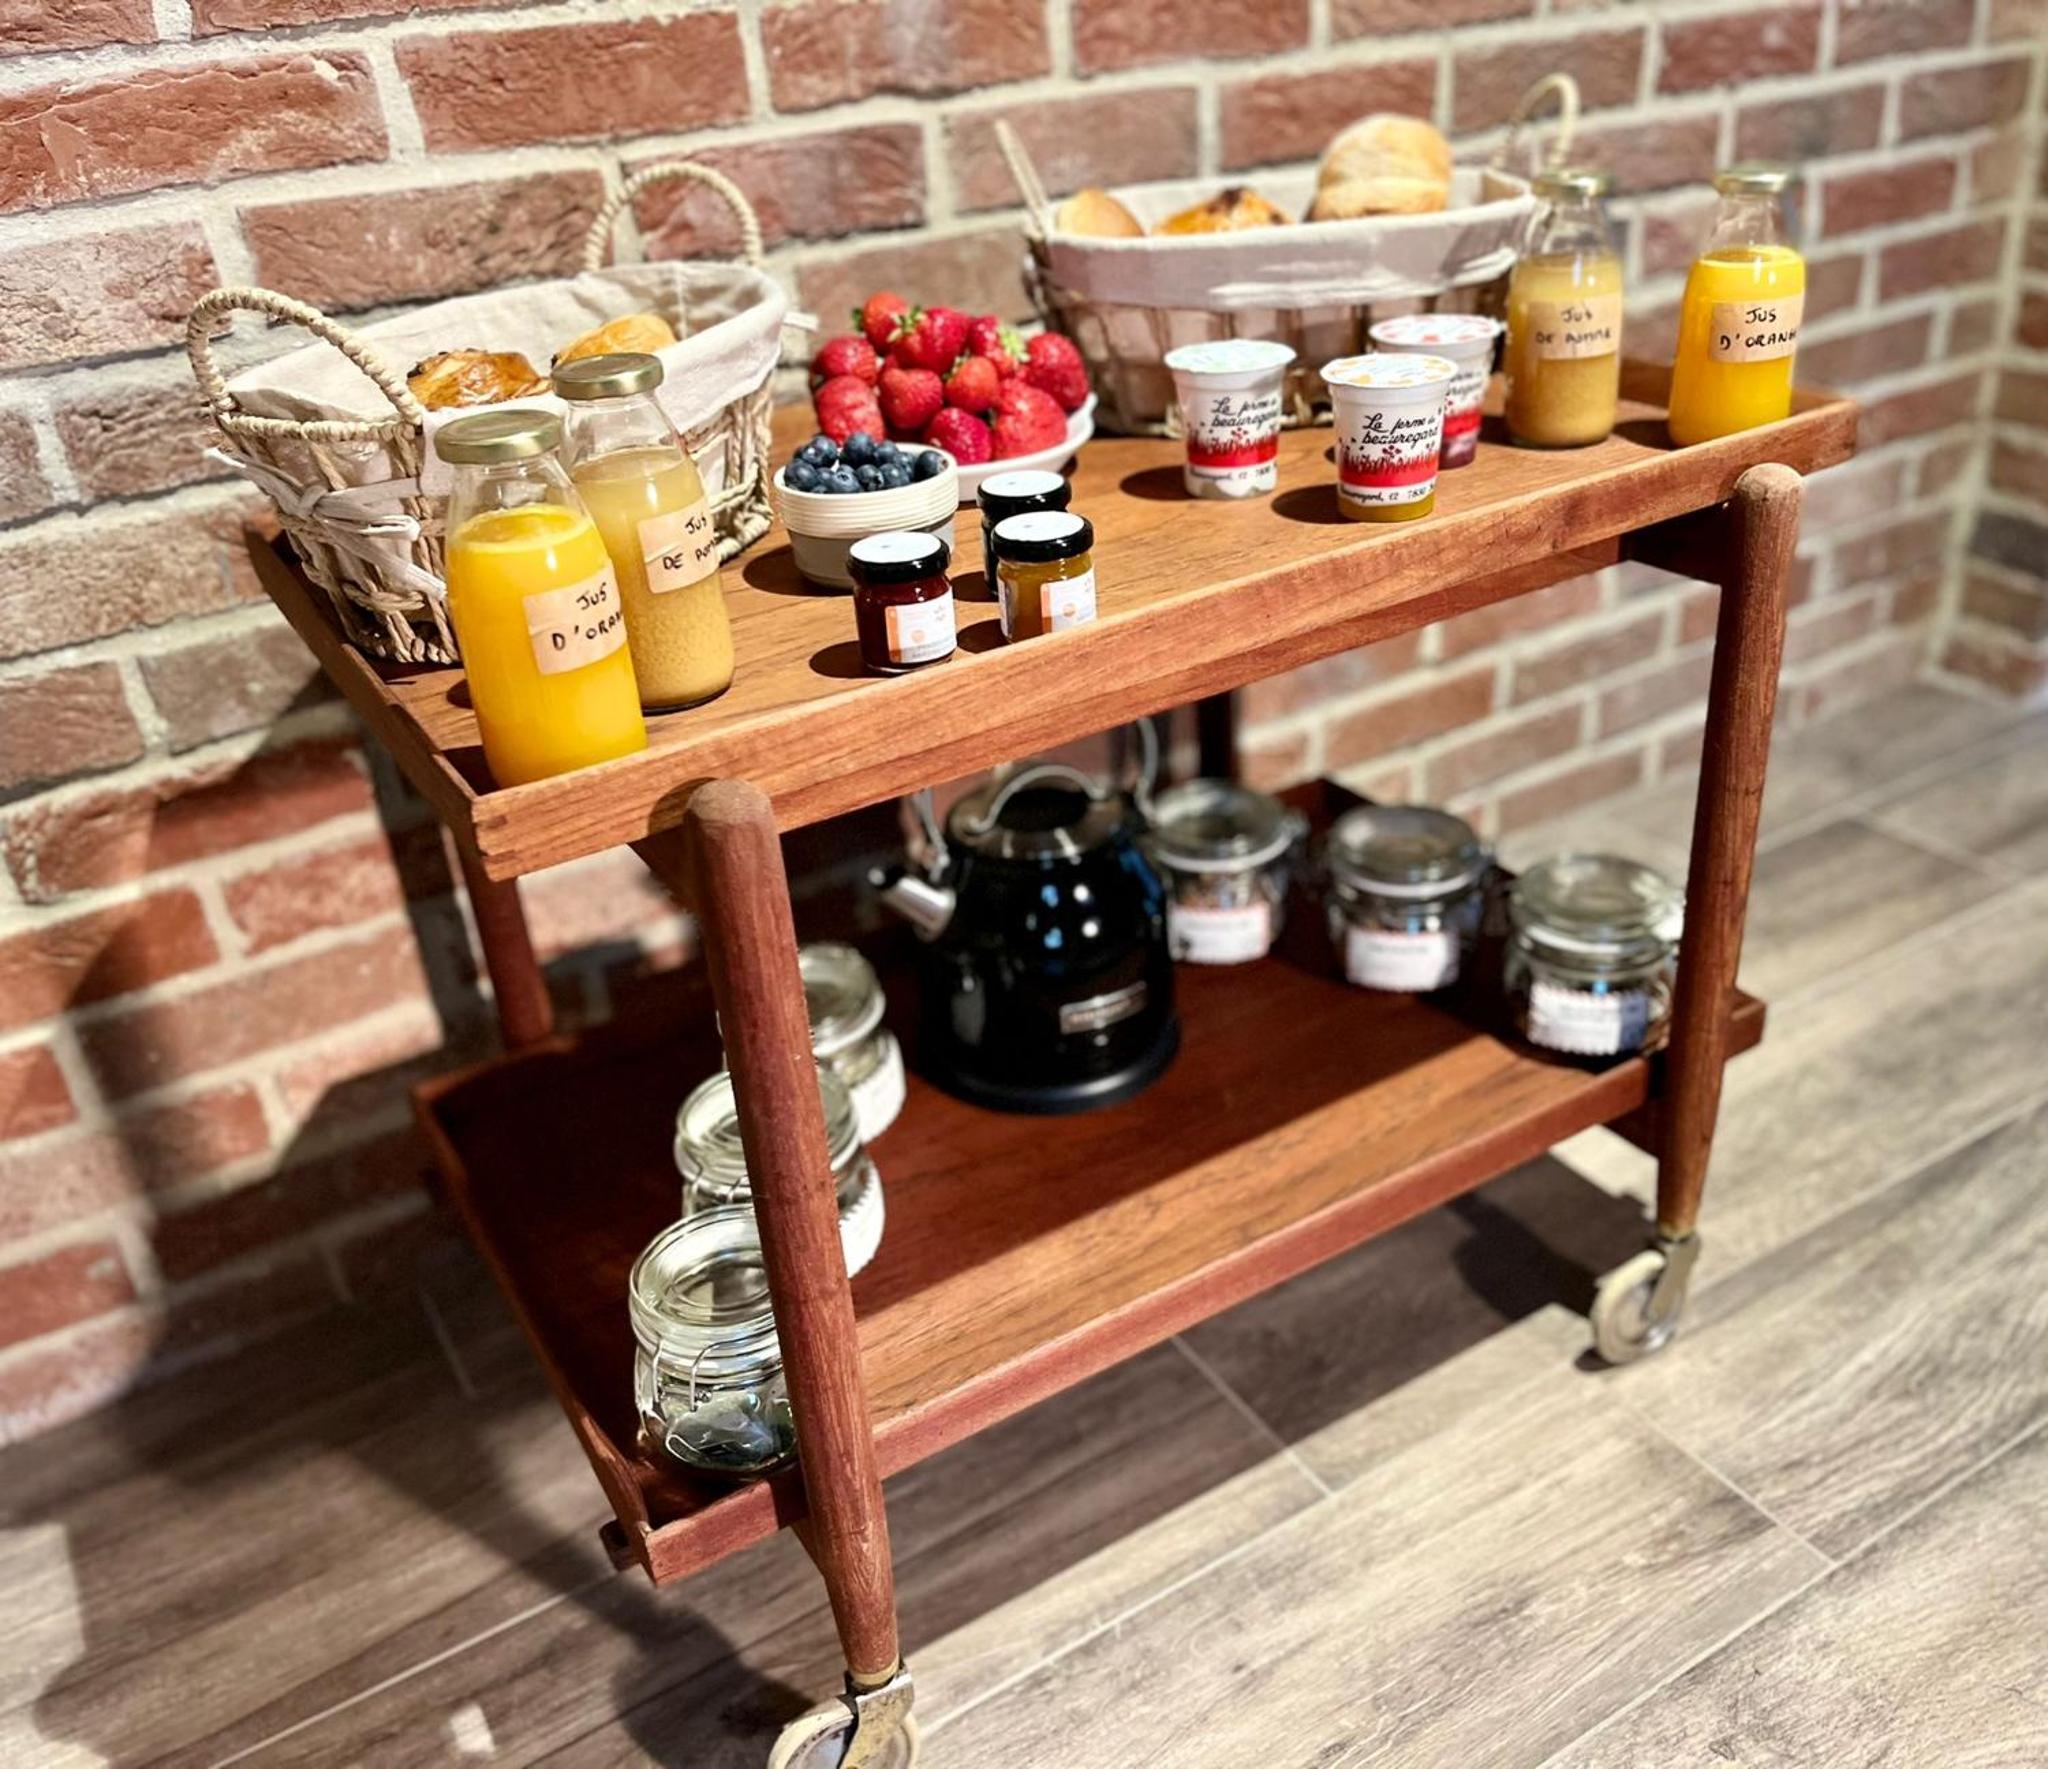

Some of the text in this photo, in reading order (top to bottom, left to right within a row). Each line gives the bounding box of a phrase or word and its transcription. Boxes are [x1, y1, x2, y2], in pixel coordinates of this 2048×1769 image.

[1745, 307, 1777, 324] JUS
[1211, 397, 1237, 416] La
[1362, 413, 1389, 433] La
[1390, 418, 1426, 435] ferme
[1362, 427, 1438, 449] beauregard
[685, 515, 708, 534] JUS
[663, 553, 683, 570] DE
[576, 582, 607, 610] JUS
